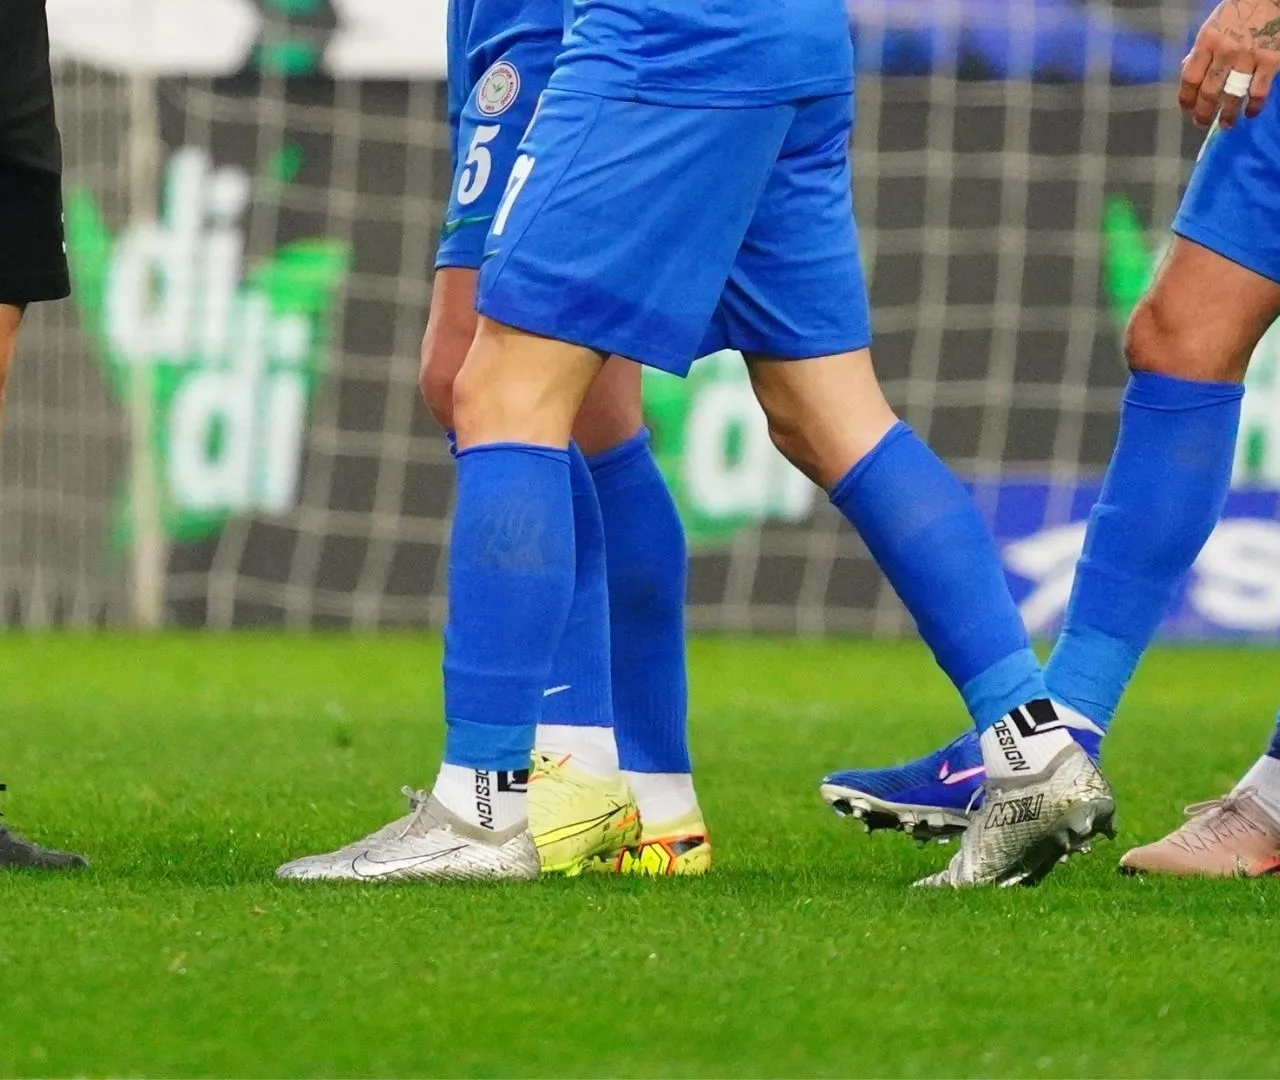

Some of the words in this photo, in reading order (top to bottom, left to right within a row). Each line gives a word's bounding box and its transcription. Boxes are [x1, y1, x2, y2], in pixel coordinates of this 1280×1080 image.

[106, 145, 250, 363] di
[457, 124, 501, 205] 5
[168, 287, 313, 515] di
